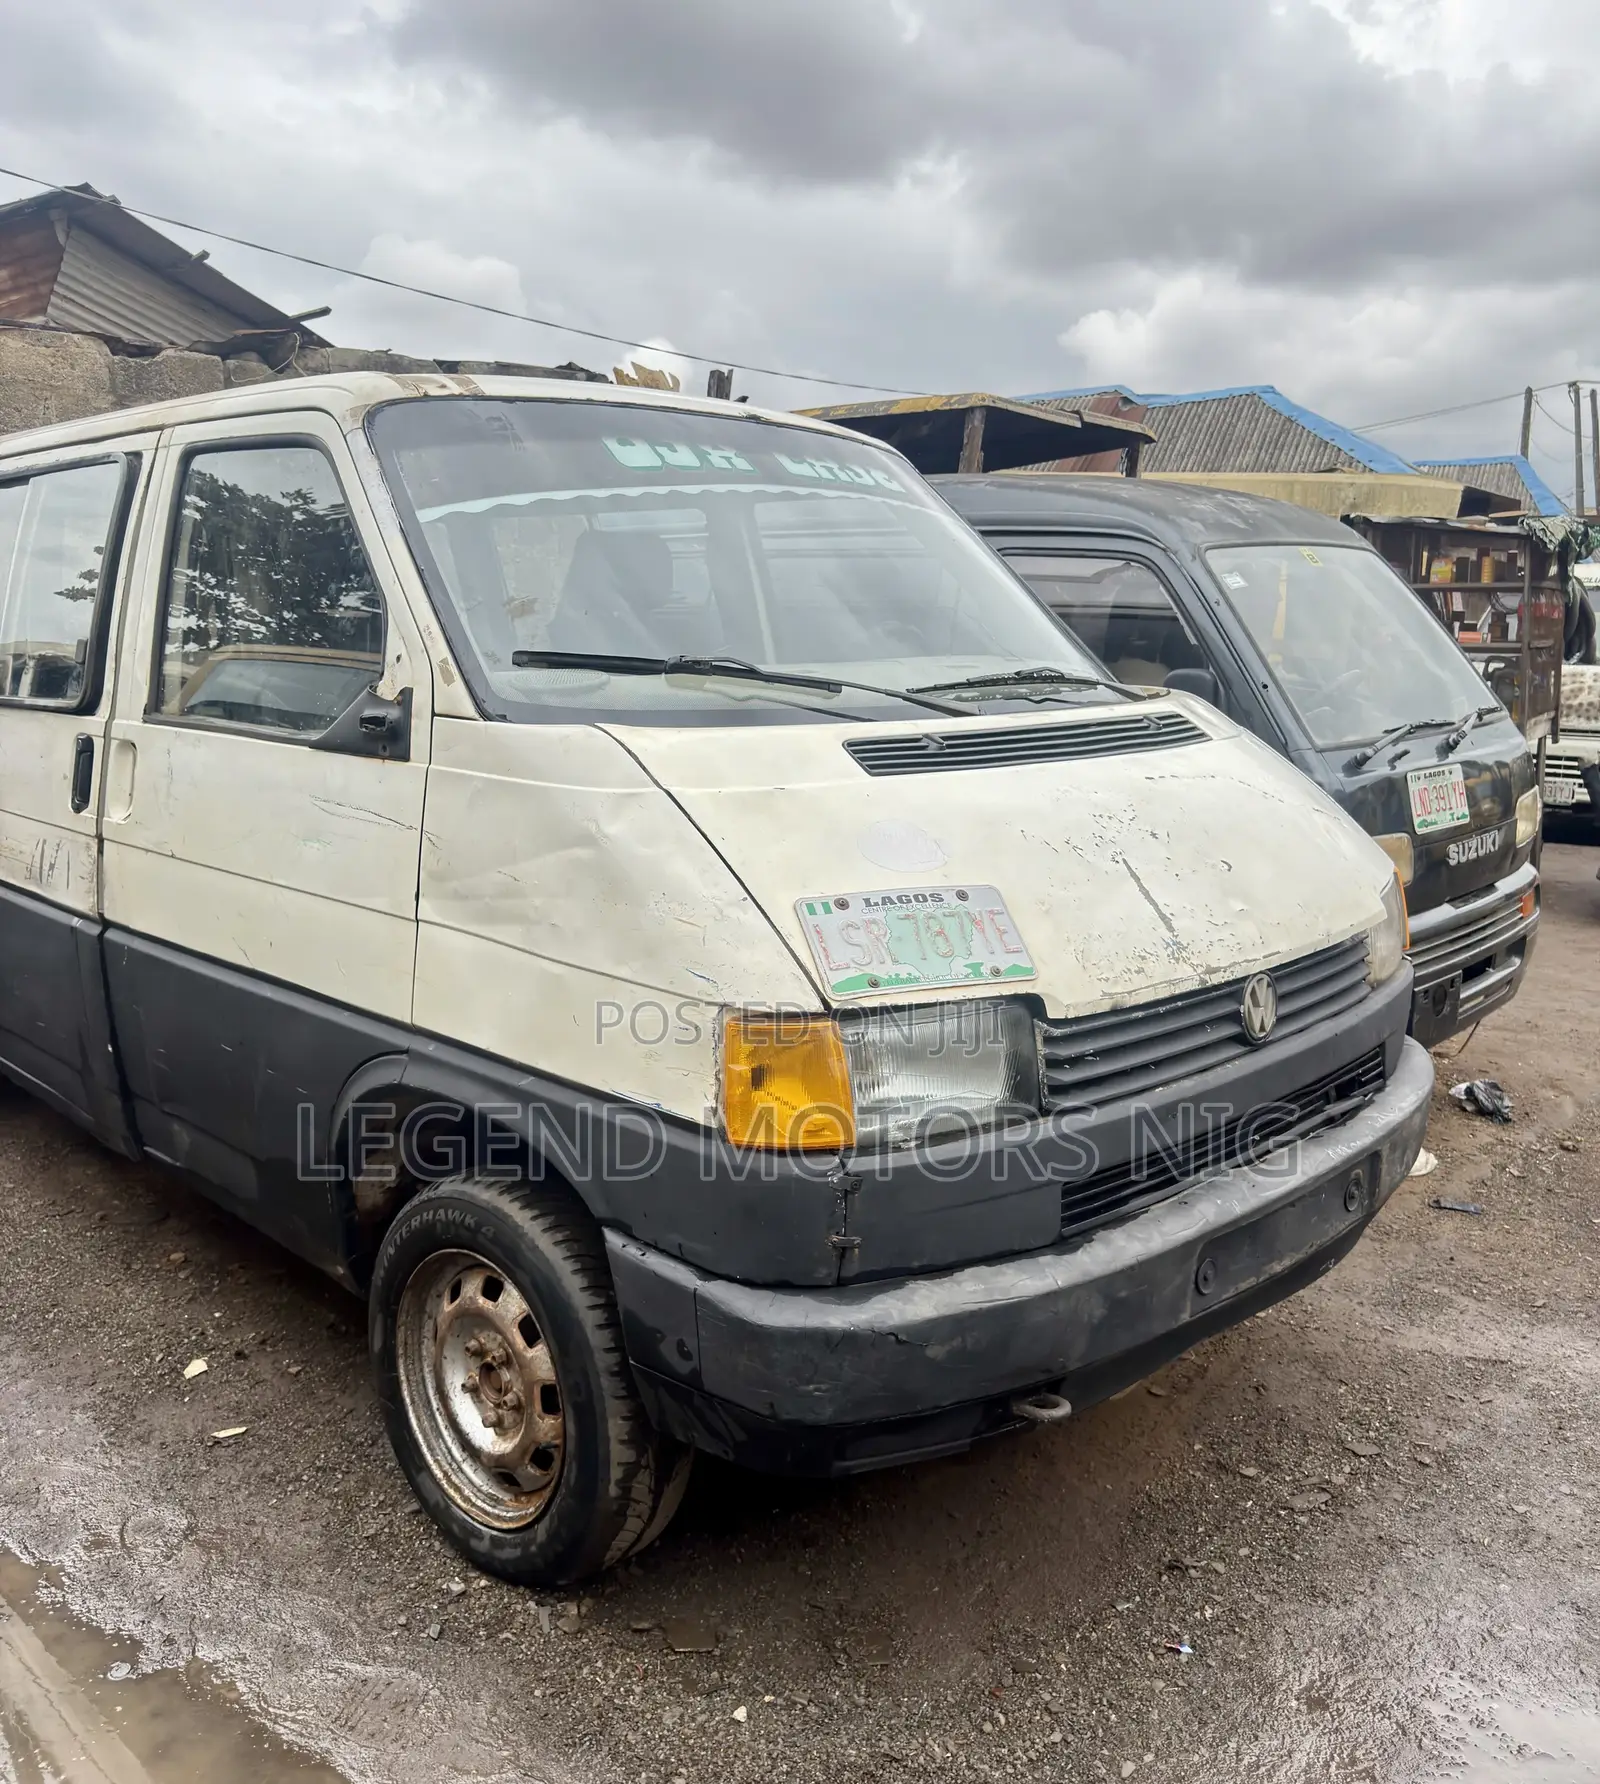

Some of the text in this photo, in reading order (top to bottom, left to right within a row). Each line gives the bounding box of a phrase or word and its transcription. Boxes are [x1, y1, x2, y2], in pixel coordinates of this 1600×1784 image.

[1424, 769, 1446, 779] LAGOS
[1447, 829, 1500, 866] SUZUKI
[862, 893, 944, 907] LAGOS
